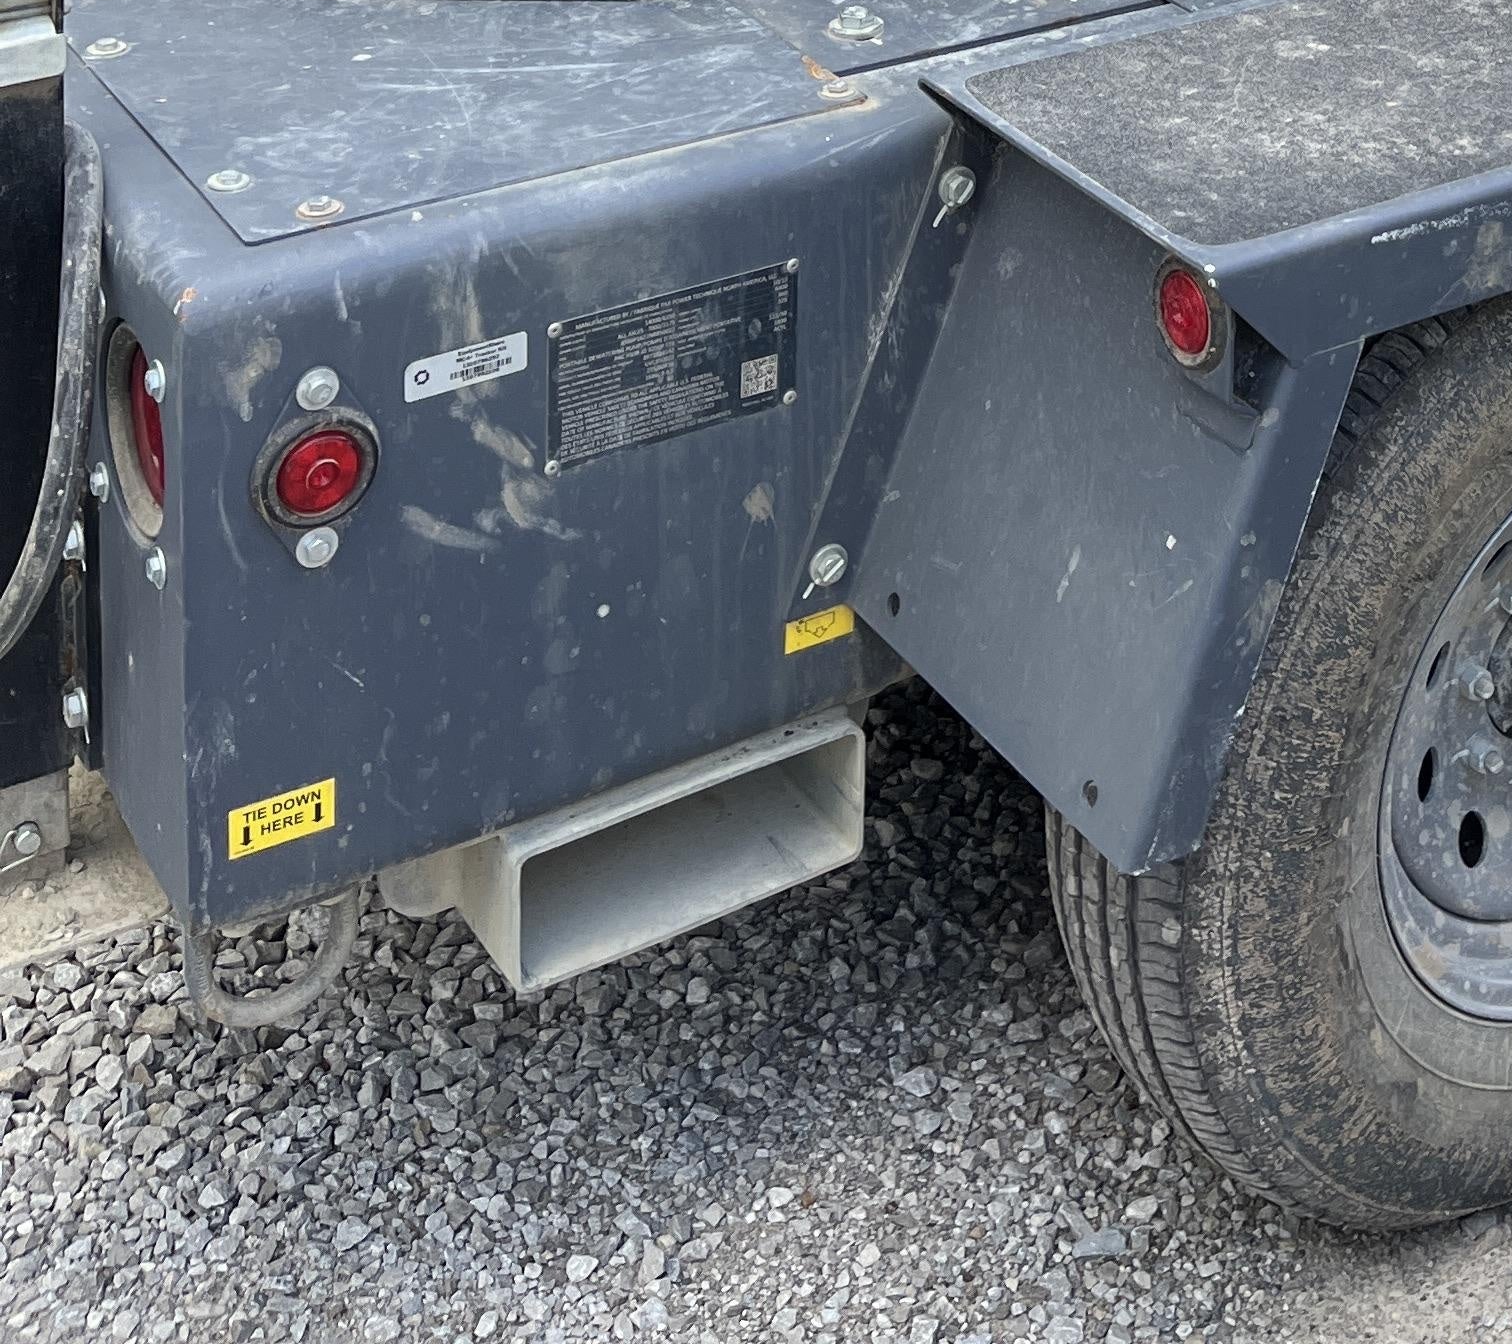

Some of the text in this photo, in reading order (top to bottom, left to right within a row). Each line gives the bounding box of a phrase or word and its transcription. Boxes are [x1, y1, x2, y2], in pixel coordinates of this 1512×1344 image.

[243, 790, 321, 823] TIE DOWN
[260, 812, 304, 835] HERE
